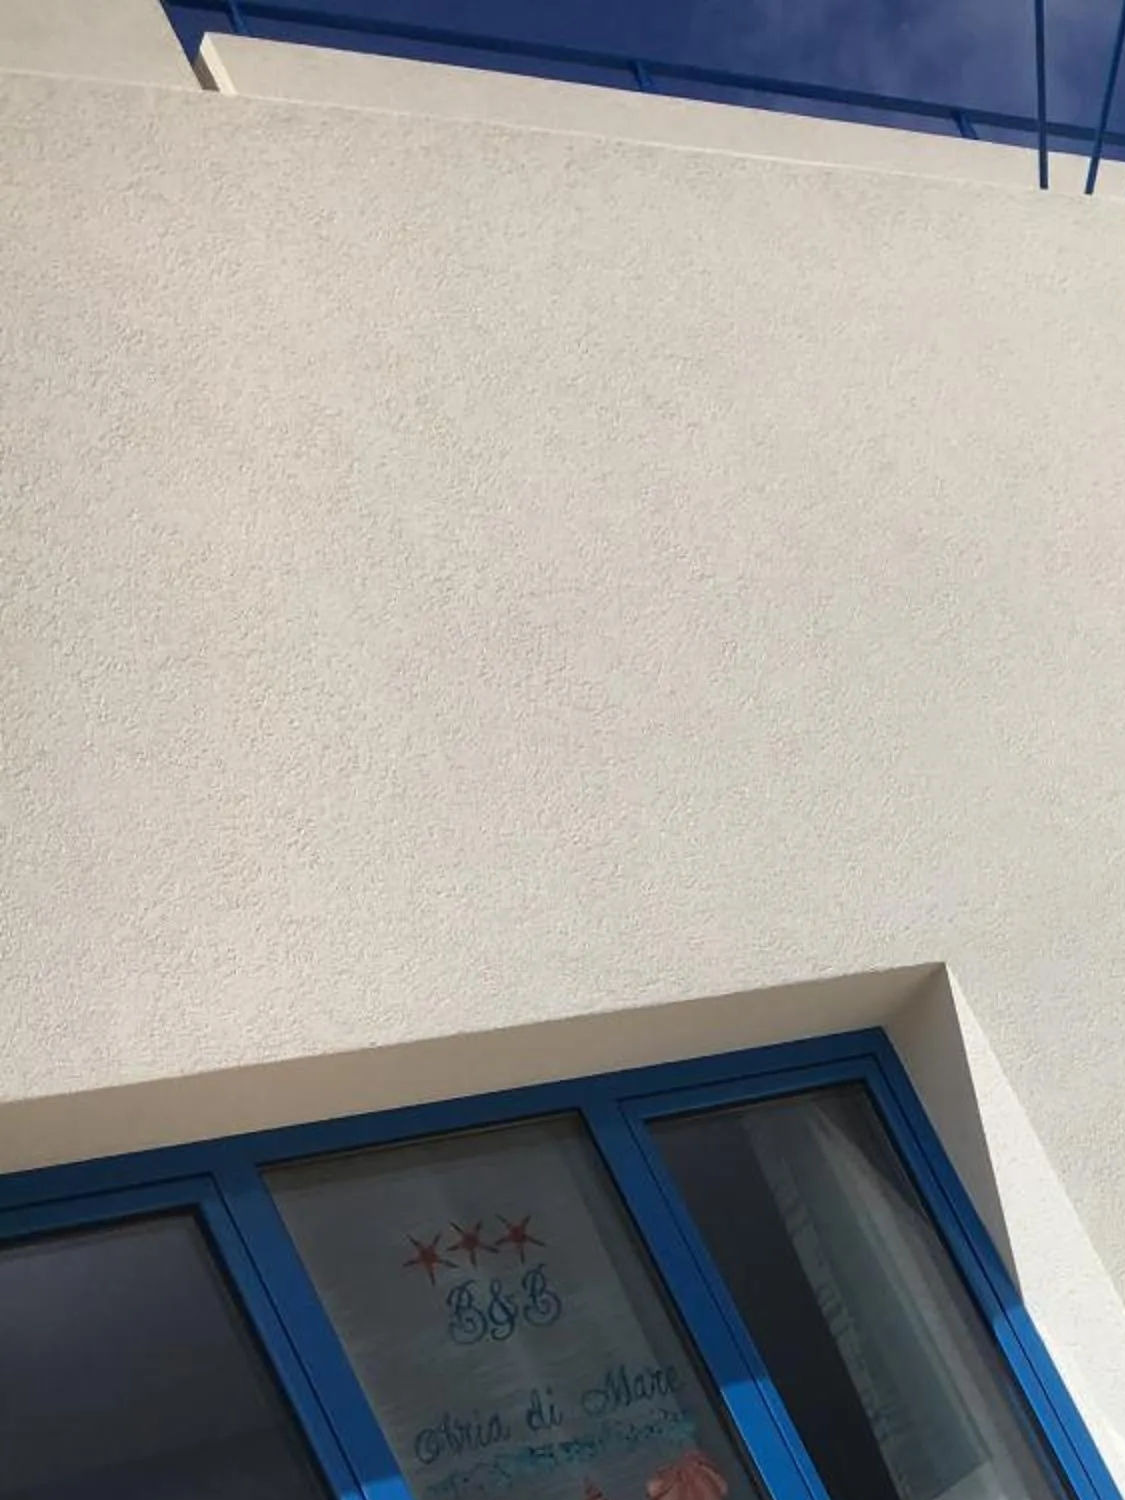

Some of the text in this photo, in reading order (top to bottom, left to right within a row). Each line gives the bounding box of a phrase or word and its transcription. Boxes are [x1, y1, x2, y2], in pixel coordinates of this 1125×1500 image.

[447, 1263, 562, 1345] B&B
[415, 1364, 687, 1466] Aria di Mare
